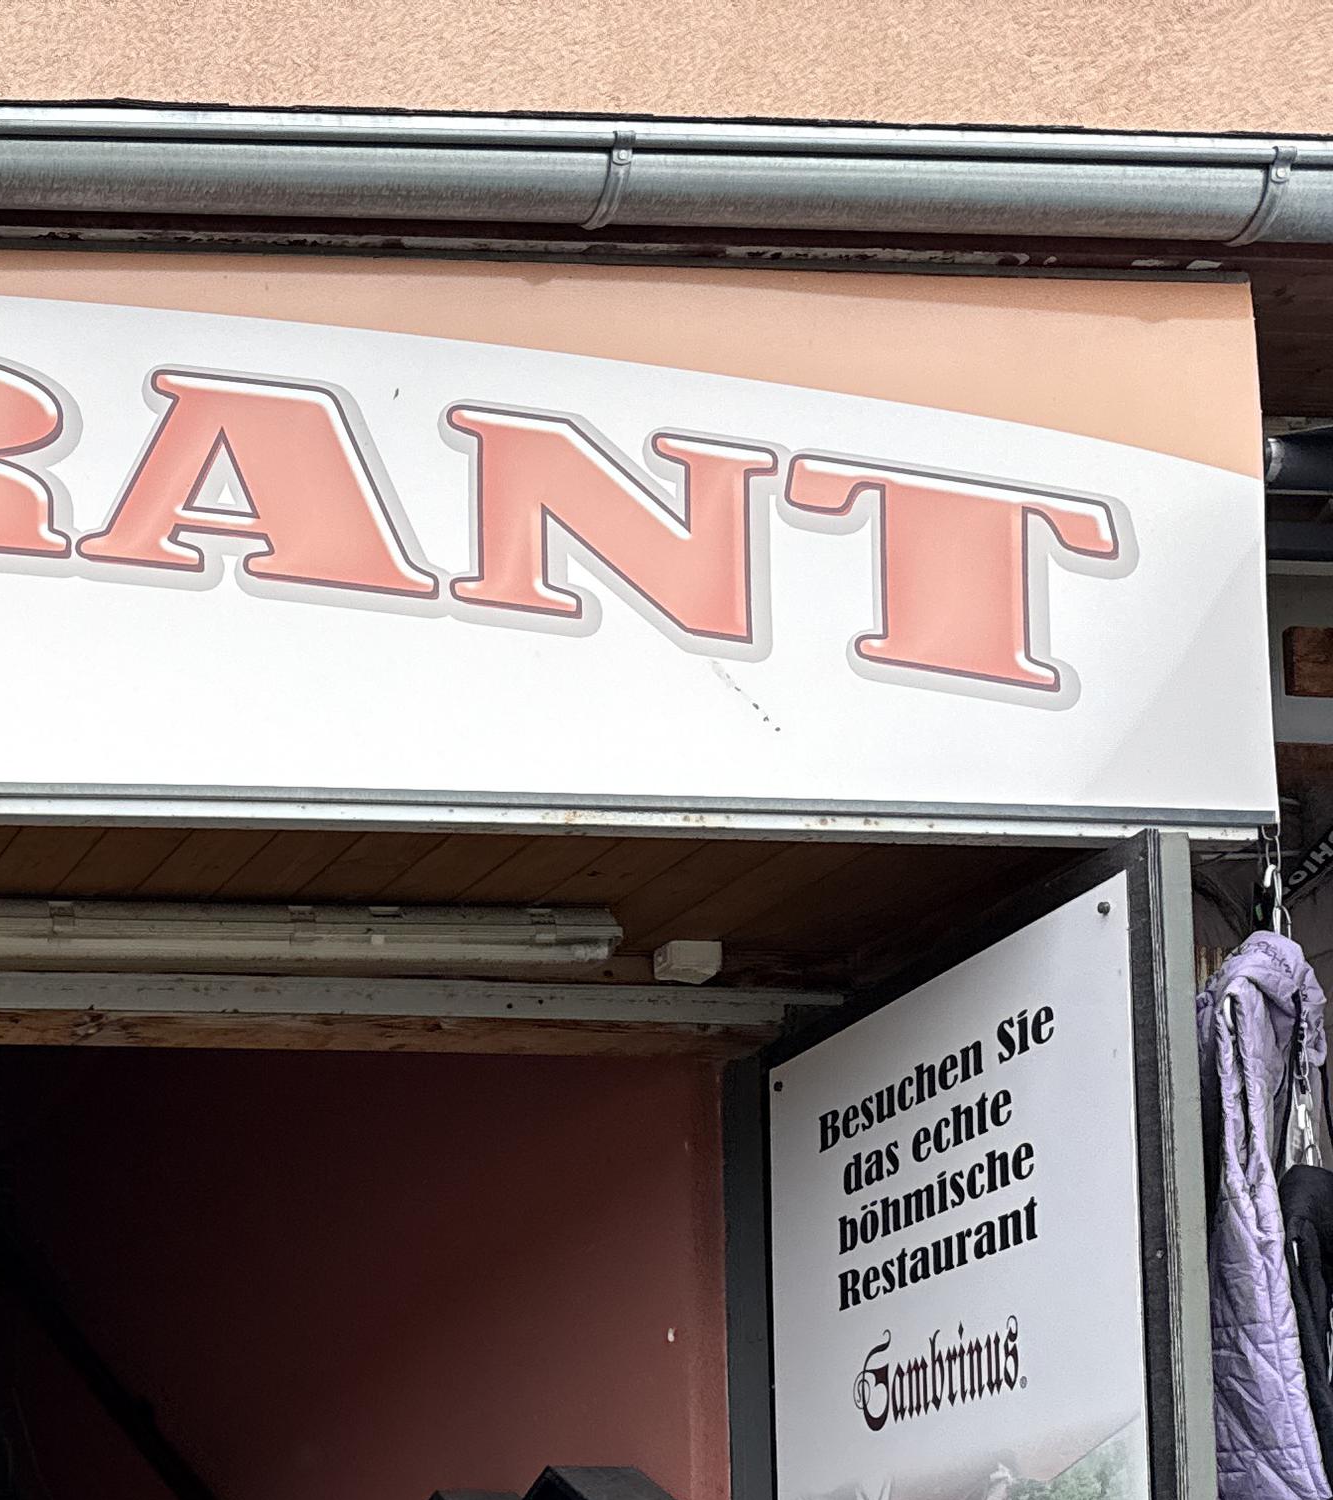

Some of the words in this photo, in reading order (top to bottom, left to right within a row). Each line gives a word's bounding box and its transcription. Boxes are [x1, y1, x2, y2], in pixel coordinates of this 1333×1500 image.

[819, 1042, 984, 1153] Besuchen
[997, 1004, 1054, 1064] Sie
[839, 1143, 1035, 1255] böhmische
[843, 1146, 900, 1195] das
[912, 1090, 1012, 1161] echte
[838, 1196, 1038, 1311] Restaurant
